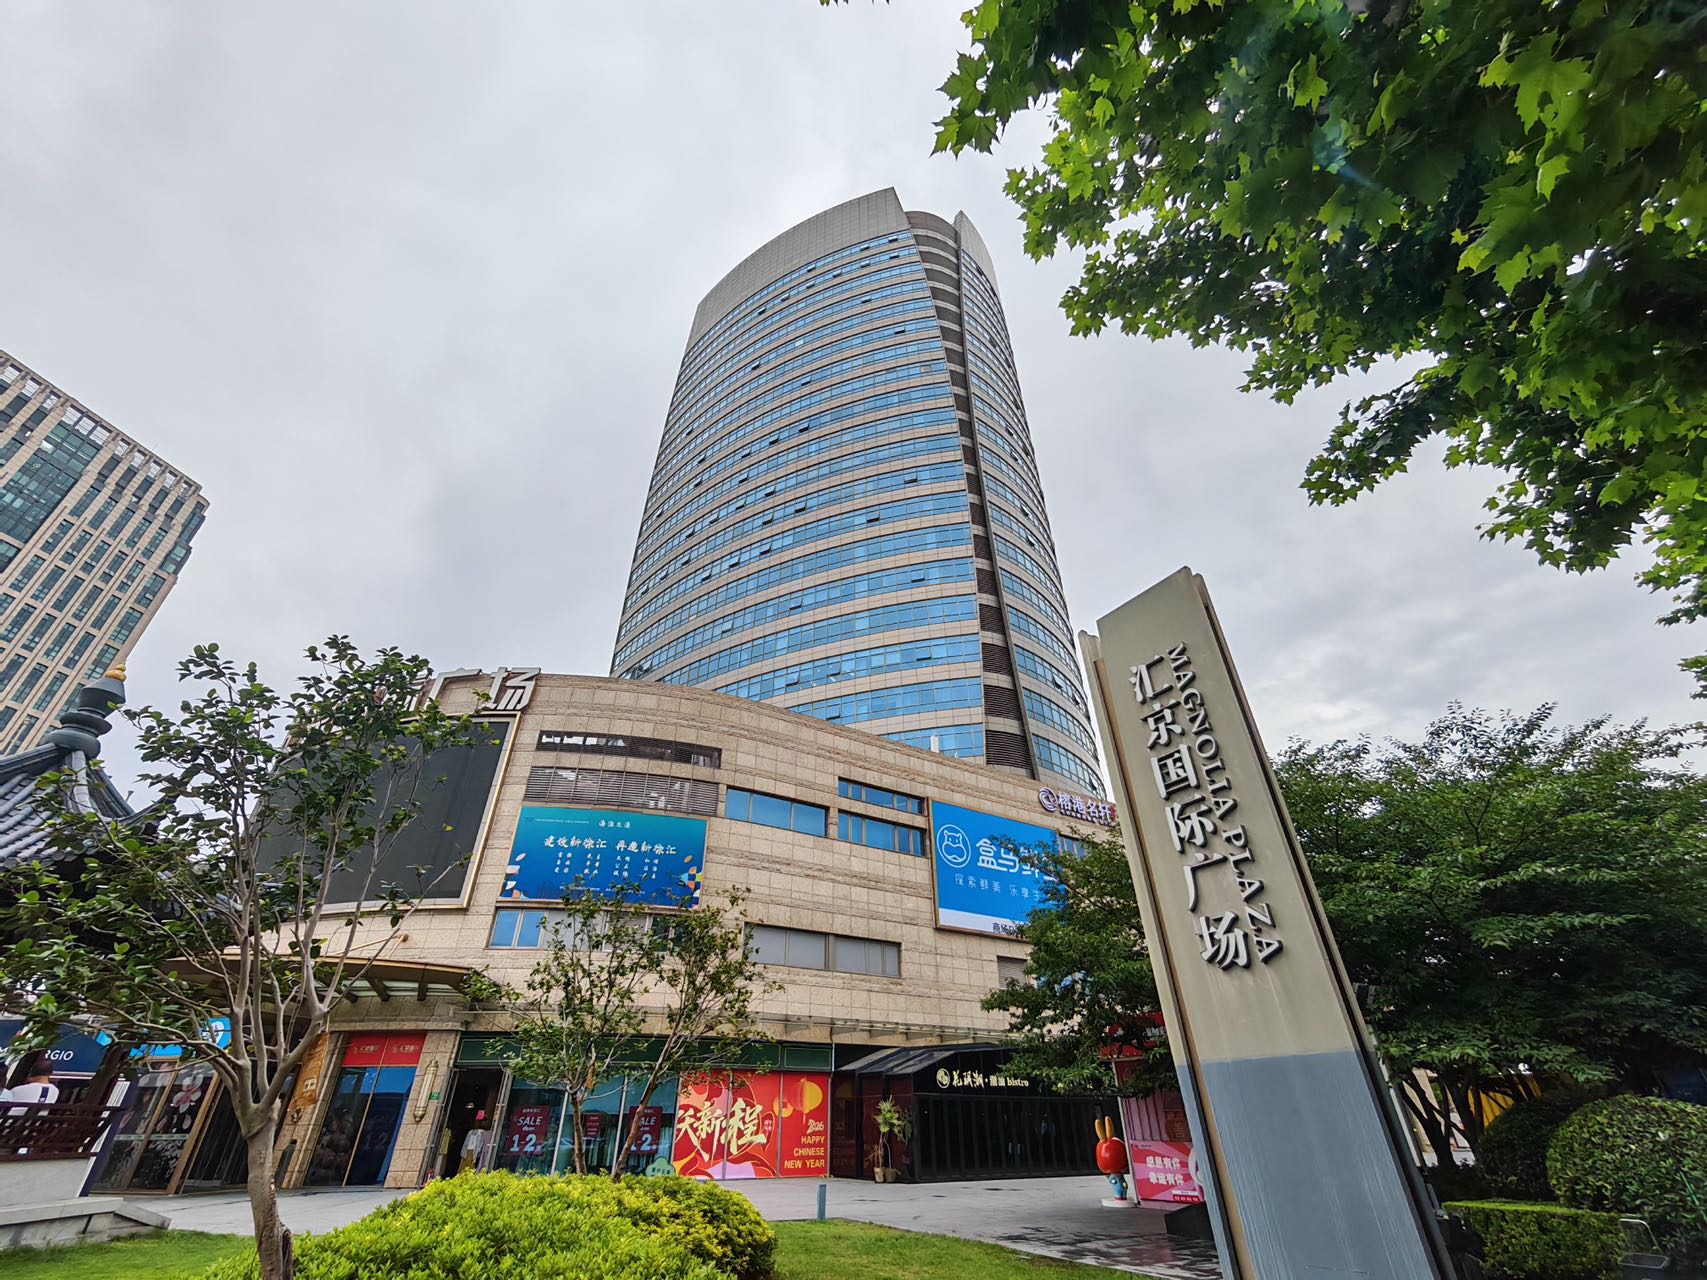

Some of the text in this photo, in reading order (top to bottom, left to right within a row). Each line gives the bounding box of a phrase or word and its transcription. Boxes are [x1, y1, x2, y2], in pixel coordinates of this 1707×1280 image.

[1168, 641, 1284, 965] MAGNOLIA PLAZA
[1129, 655, 1251, 970] 汇京国际广场
[544, 834, 607, 850] 建设新徐汇
[976, 838, 1060, 882] 盒马
[1007, 1077, 1029, 1087] bistro
[517, 1116, 543, 1126] SALE
[639, 1116, 656, 1126] ALE
[801, 1135, 825, 1144] HAPPY
[793, 1147, 825, 1157] CHINESE
[784, 1159, 825, 1169] NEW YEAR
